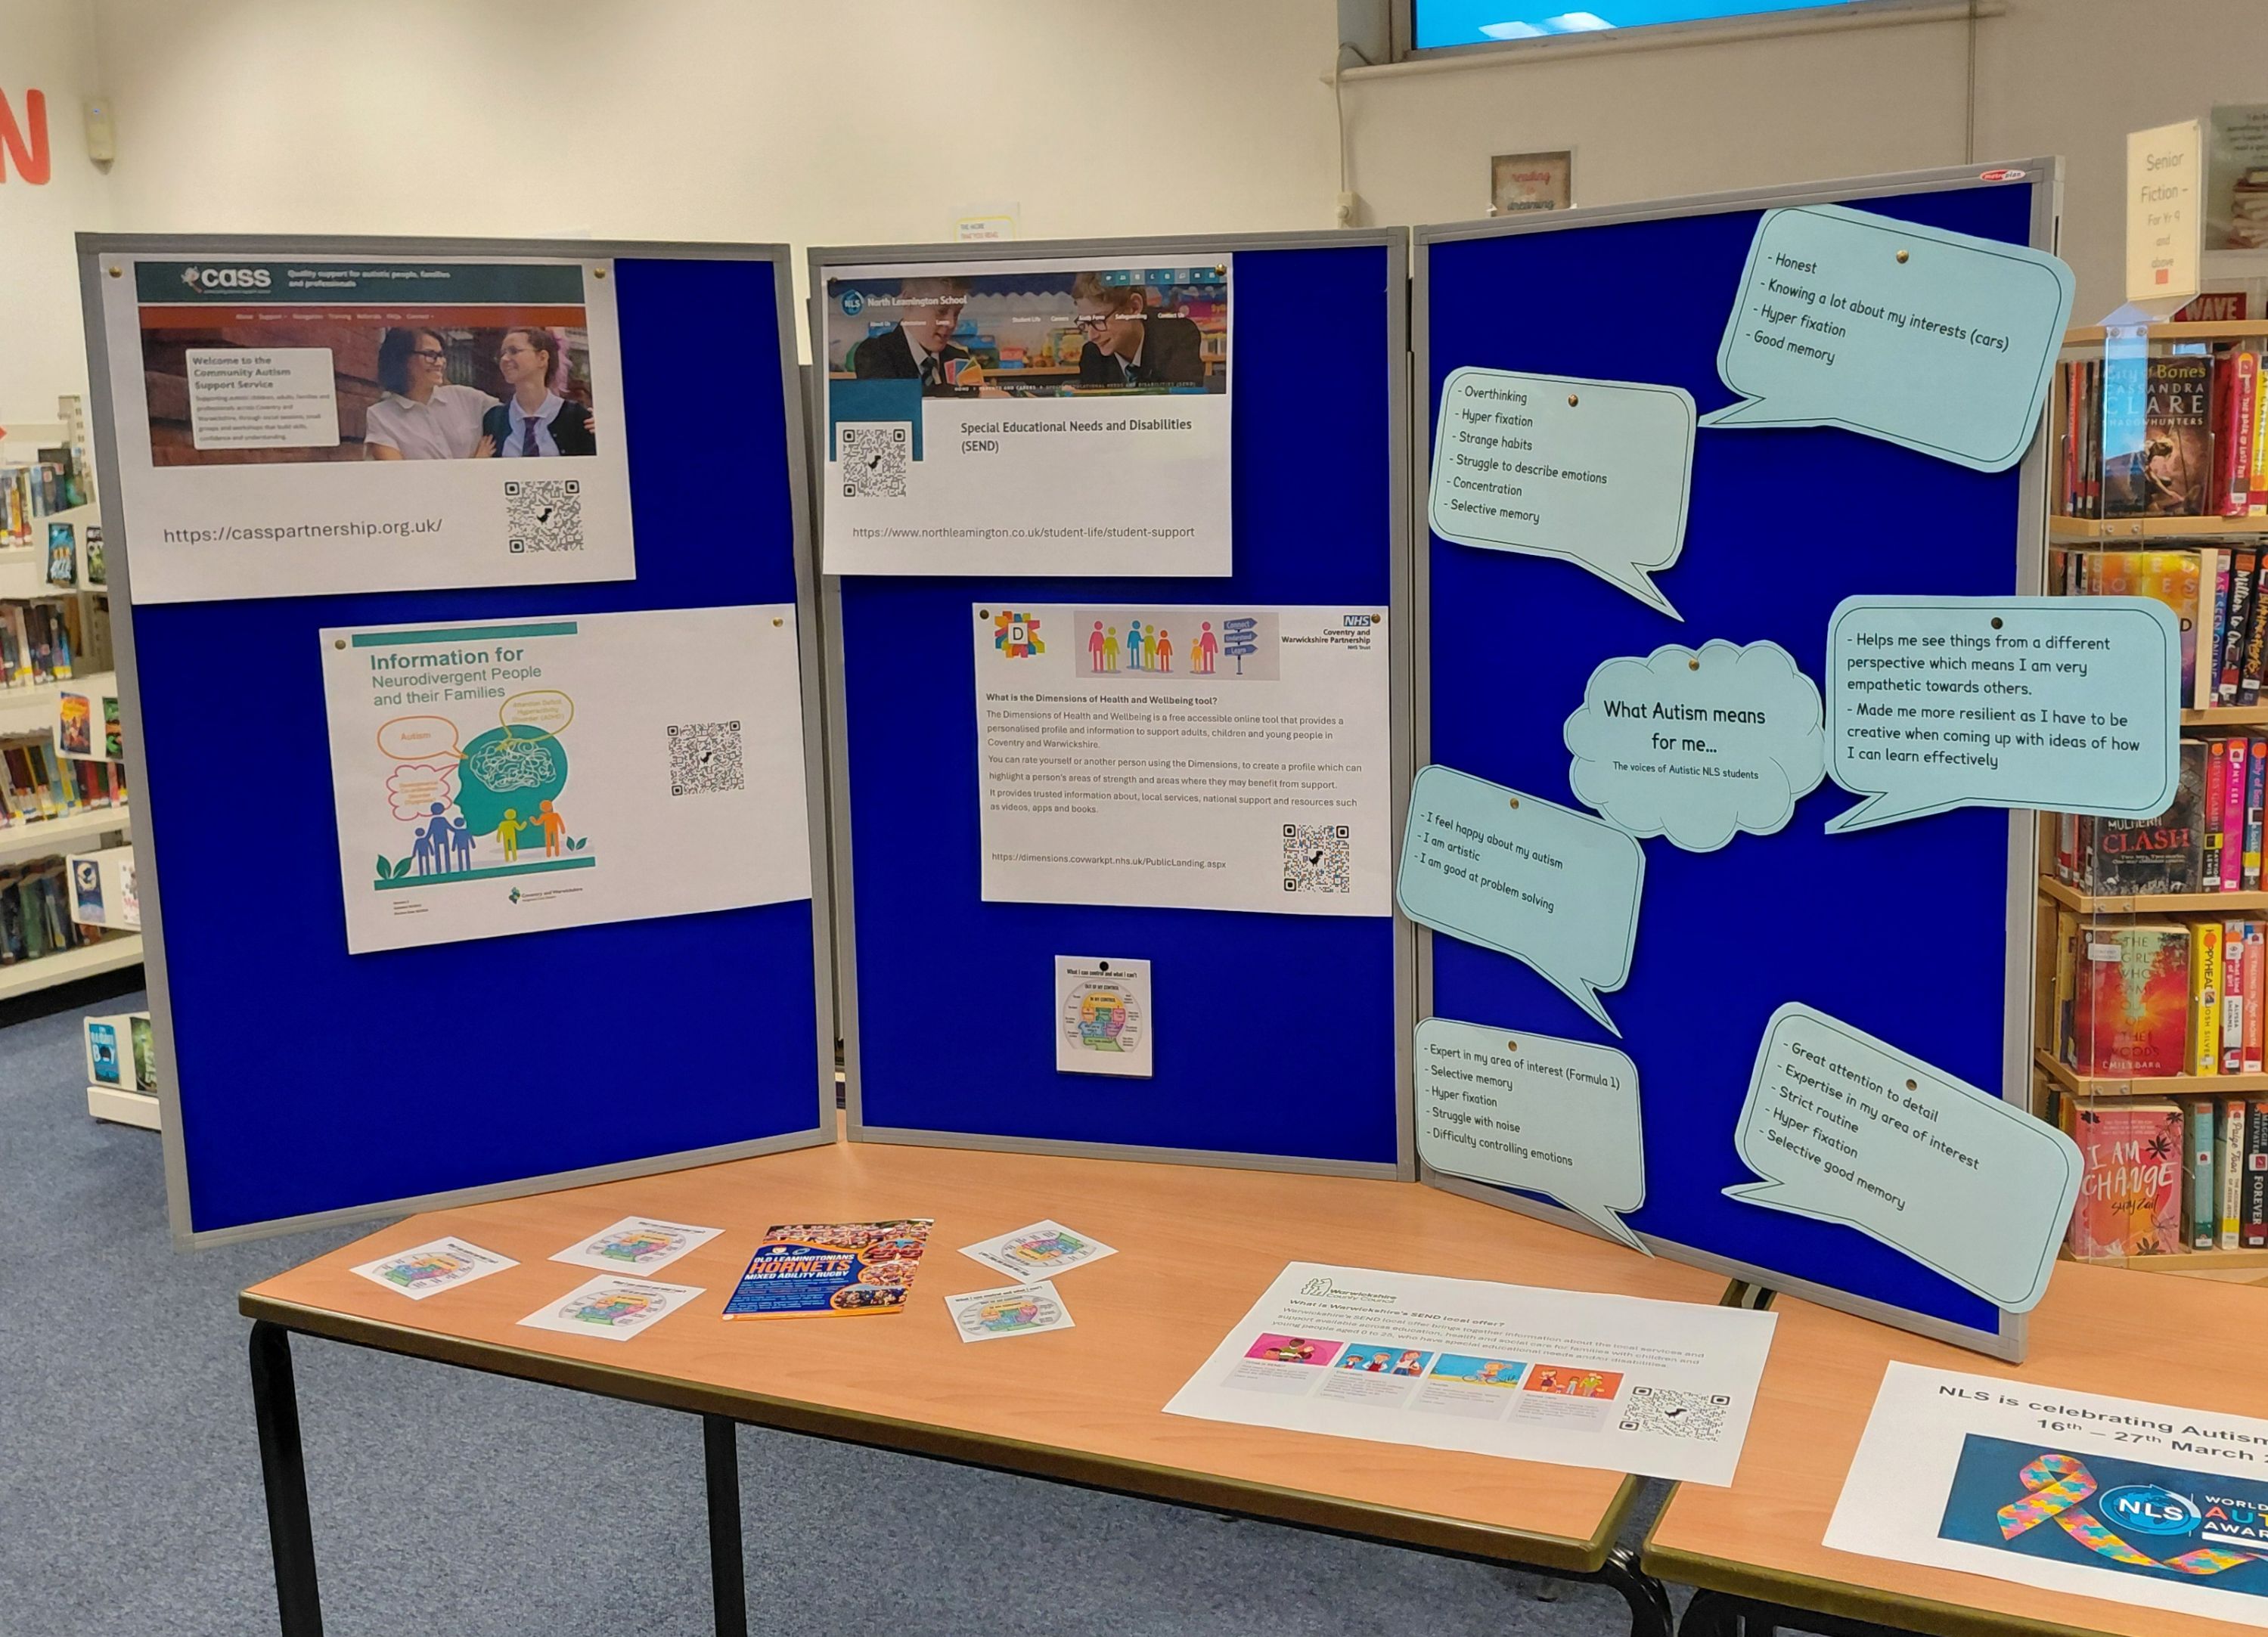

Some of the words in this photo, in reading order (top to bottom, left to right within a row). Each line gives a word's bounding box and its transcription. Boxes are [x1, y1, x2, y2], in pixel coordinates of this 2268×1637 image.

[2147, 153, 2184, 172] Senior
[2141, 185, 2178, 203] Fiction
[2148, 215, 2162, 226] For
[2163, 212, 2173, 224] Yr
[2157, 235, 2170, 246] and
[1774, 251, 1817, 274] Honest
[2151, 257, 2174, 268] above
[201, 268, 271, 287] cass
[867, 298, 890, 306] North
[892, 297, 939, 307] Leamington
[940, 296, 967, 305] School
[2185, 297, 2237, 321] WAVE
[1768, 277, 1816, 305] Knowing
[1818, 295, 1827, 305] a
[1829, 292, 1848, 310] lot
[1848, 299, 1885, 319] about
[1886, 312, 1907, 328] my
[1909, 313, 1967, 339] interests
[1969, 328, 2009, 353] (cars)
[1753, 330, 1786, 349] Good
[1786, 342, 1835, 366] memory
[192, 355, 239, 365] Welcome
[254, 355, 271, 364] the
[194, 367, 253, 378] Community
[254, 367, 291, 377] Autism
[2157, 364, 2206, 378] Bones
[194, 380, 235, 392] Support
[237, 380, 274, 389] Service
[1464, 384, 1528, 406] Overthinking
[2107, 395, 2204, 414] CLARE
[960, 422, 1000, 436] Special
[1003, 420, 1067, 433] Educational
[1069, 420, 1103, 432] Needs
[1106, 419, 1126, 431] and
[1128, 417, 1192, 430] Disabilities
[960, 440, 999, 454] (SEND)
[1455, 452, 1499, 472] Struggle
[1502, 460, 1513, 472] to
[1514, 460, 1559, 478] describe
[1561, 470, 1607, 484] emotions
[163, 517, 442, 545] https://casspartnership.org.uk/
[852, 526, 1195, 540] https://www.northleamington.co.uk/student-life/student-support
[1345, 616, 1370, 626] NHS
[1013, 627, 1023, 641] D
[1281, 635, 1329, 643] Warwickshire
[1329, 635, 1371, 645] Partnership
[1322, 628, 1356, 637] Coventry
[1355, 628, 1371, 636] and
[1856, 632, 1894, 650] Helps
[1897, 637, 1918, 646] me
[1921, 637, 1946, 646] see
[1950, 634, 1991, 651] things
[1995, 634, 2028, 648] from
[2031, 638, 2041, 649] a
[2045, 635, 2111, 650] different
[371, 649, 489, 671] Information
[495, 646, 524, 662] for
[371, 668, 487, 689] Neurodivergent
[490, 665, 541, 681] People
[1847, 677, 1922, 694] empathetic
[1925, 679, 1979, 693] towards
[1983, 681, 2032, 696] others.
[374, 691, 402, 706] and
[405, 690, 440, 705] their
[443, 685, 506, 702] Families
[985, 693, 1009, 702] What
[1010, 693, 1019, 702] is
[1035, 693, 1087, 703] Dimensions
[1089, 694, 1098, 703] of
[1100, 694, 1129, 704] Health
[1130, 696, 1148, 704] and
[1148, 696, 1194, 707] Wellbeing
[1195, 696, 1218, 705] tool?
[1603, 700, 1648, 719] What
[1652, 702, 1708, 721] Autism
[1712, 709, 1766, 724] means
[401, 732, 431, 741] Autism
[1650, 732, 1677, 750] for
[1682, 738, 1717, 753] me...
[1611, 761, 1628, 771] The
[1629, 762, 1656, 773] voices
[1658, 764, 1667, 773] of
[1668, 764, 1701, 776] Autistic
[1702, 765, 1720, 777] NLS
[1721, 768, 1759, 780] students
[1426, 811, 1433, 823] I
[1434, 814, 1454, 830] feel
[1455, 821, 1485, 844] happy
[1485, 833, 1514, 851] about
[1514, 845, 1530, 860] my
[1531, 851, 1563, 870] autism
[2102, 829, 2190, 853] CLASH
[2124, 937, 2148, 947] THE
[1429, 1043, 1461, 1059] Expert
[1463, 1049, 1472, 1061] in
[1473, 1053, 1488, 1066] my
[1490, 1056, 1512, 1068] area
[1513, 1059, 1525, 1070] of
[1526, 1060, 1564, 1077] interest
[1565, 1068, 1609, 1087] (Formula
[1609, 1075, 1620, 1091] 1)
[1791, 1042, 1826, 1068] Great
[1829, 1062, 1883, 1095] attention
[1886, 1087, 1900, 1102] to
[1901, 1096, 1939, 1123] detail
[2087, 1144, 2106, 1170] I
[2112, 1140, 2140, 1164] AM
[1767, 1128, 1822, 1165] Selective
[1823, 1161, 1855, 1182] good
[1856, 1177, 1906, 1211] memory
[2253, 1176, 2263, 1225] FOREVER
[744, 1272, 776, 1281] MIXED
[777, 1271, 815, 1279] ABILITY
[749, 1260, 852, 1274] HORNETS
[1326, 1293, 1359, 1302] County
[1359, 1296, 1395, 1304] Council
[1329, 1288, 1398, 1300] Warwickshire
[1329, 1304, 1408, 1316] Warwickshire's
[1410, 1311, 1441, 1319] SEND
[1939, 1385, 1990, 1401] NLS
[1998, 1394, 2019, 1406] is
[2028, 1402, 2173, 1434] celebrating
[2170, 1440, 2254, 1461] March
[2119, 1498, 2184, 1522] NLS
[2205, 1495, 2268, 1511] WORLD
